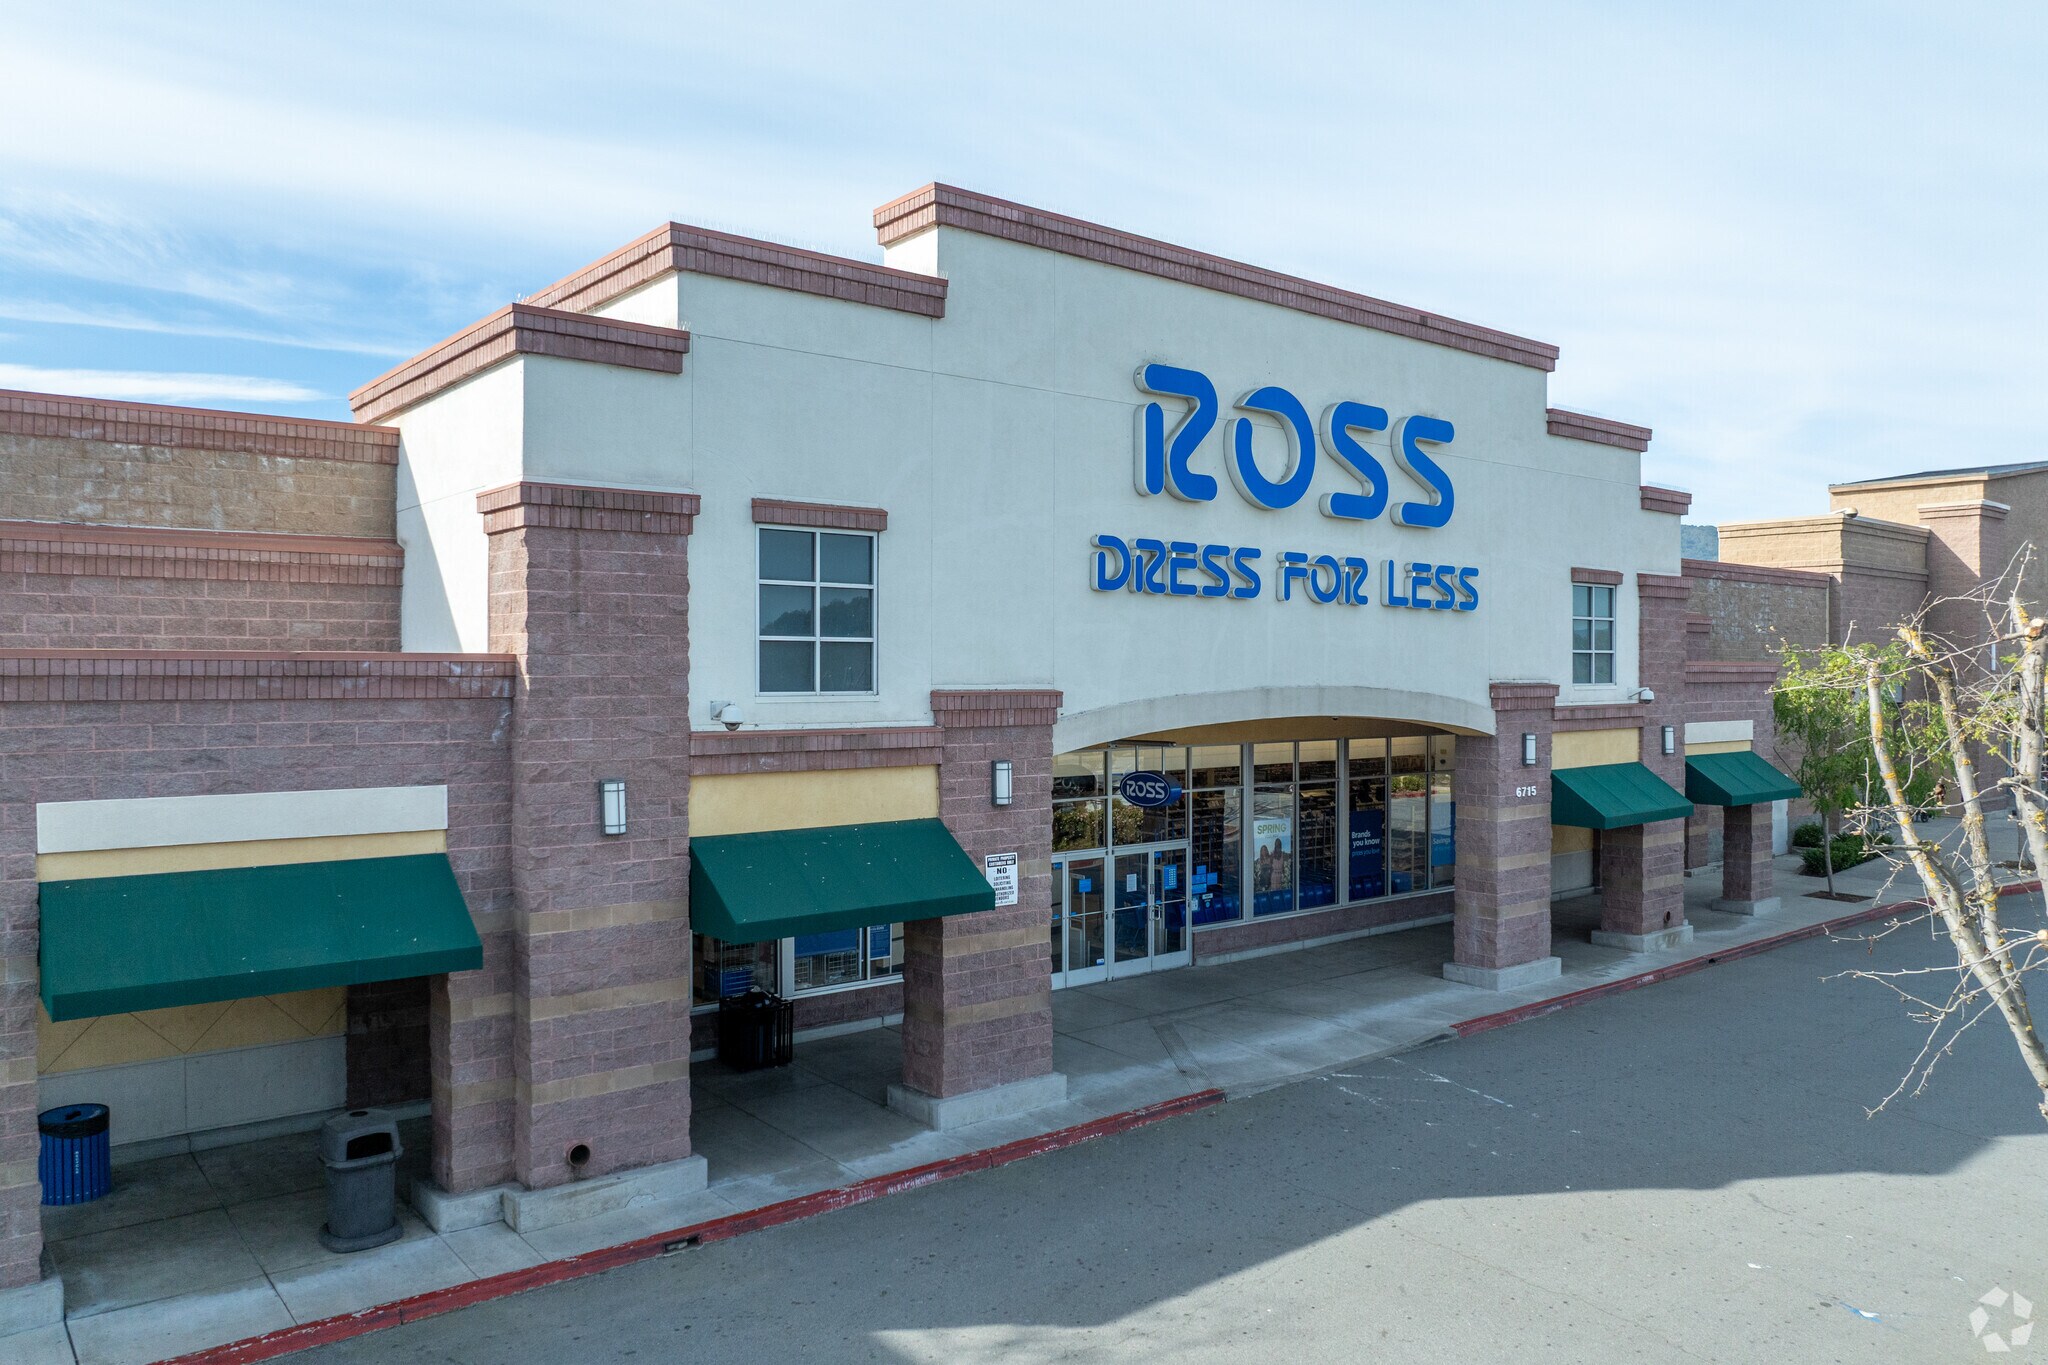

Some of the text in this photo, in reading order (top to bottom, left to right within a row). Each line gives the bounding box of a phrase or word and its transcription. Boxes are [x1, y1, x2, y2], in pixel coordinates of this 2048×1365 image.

[1134, 363, 1455, 529] ROSS
[1090, 534, 1480, 611] DRESS FOR LESS
[1126, 780, 1166, 799] ROSS
[1515, 785, 1537, 798] 6715
[1257, 822, 1287, 835] SPRING
[1351, 830, 1371, 839] Brands
[1352, 838, 1380, 849] you know
